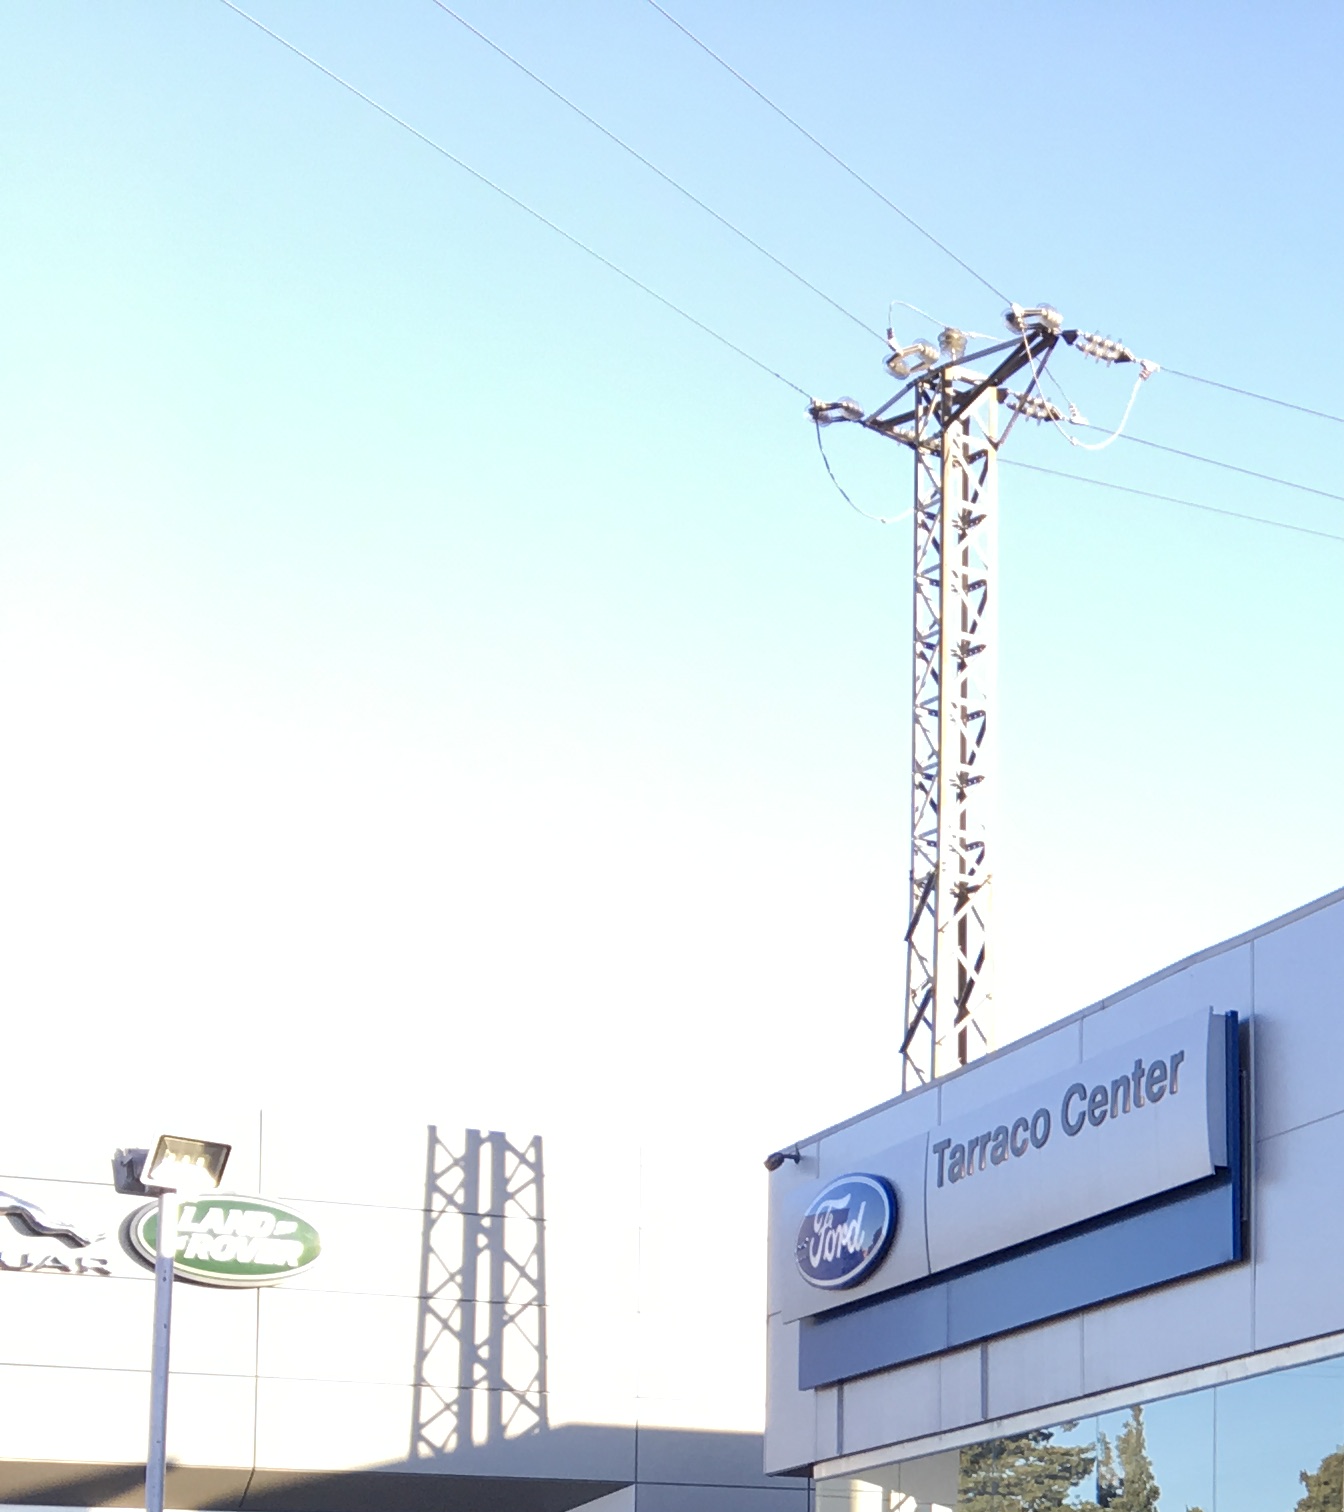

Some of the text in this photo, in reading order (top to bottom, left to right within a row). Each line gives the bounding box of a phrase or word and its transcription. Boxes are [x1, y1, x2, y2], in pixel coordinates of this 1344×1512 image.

[932, 1050, 1185, 1188] Tarraco Center
[178, 1205, 277, 1238] LAND
[809, 1192, 865, 1268] Ford
[183, 1232, 304, 1267] ROVER
